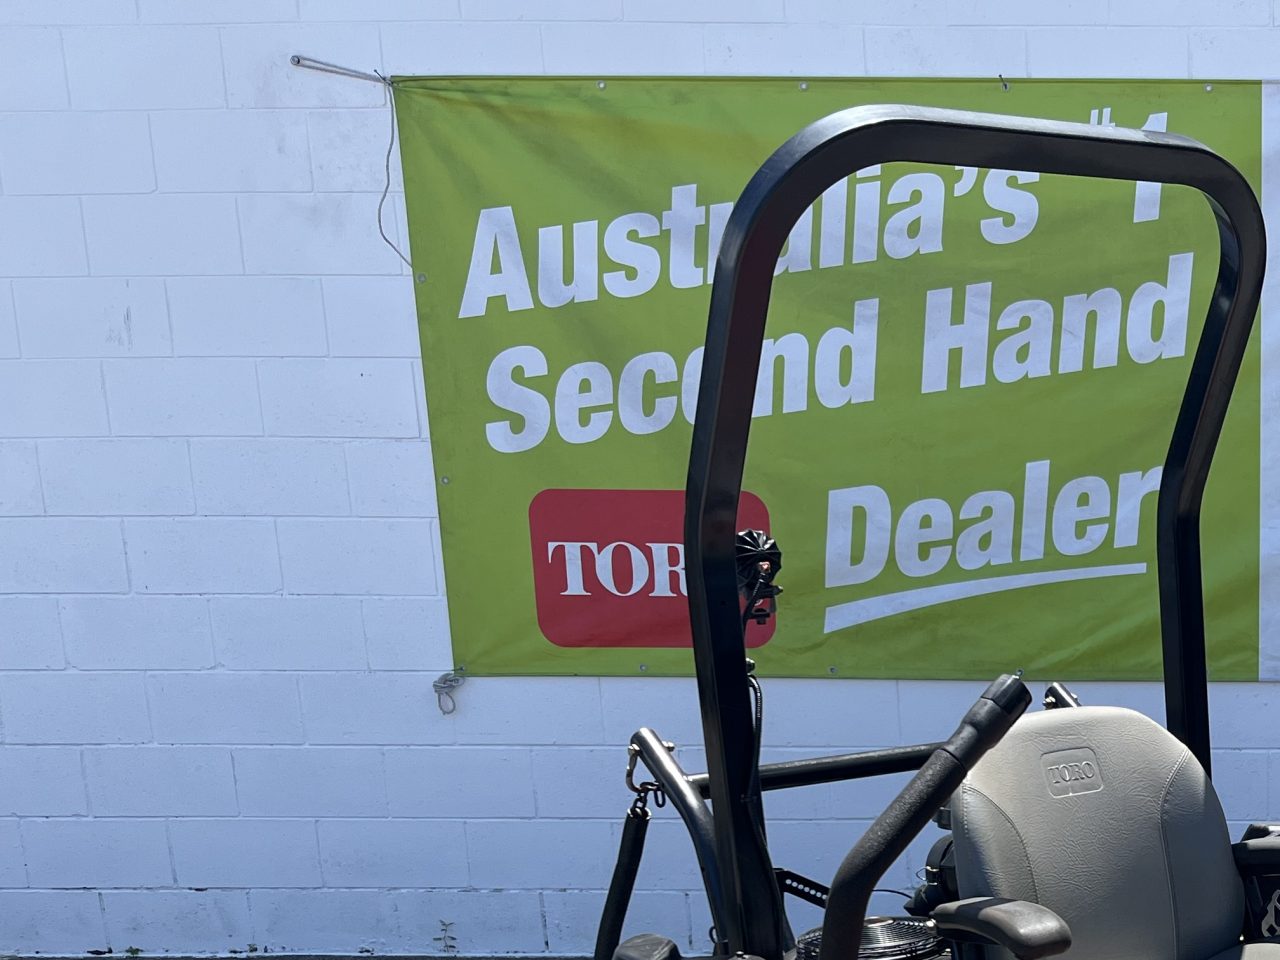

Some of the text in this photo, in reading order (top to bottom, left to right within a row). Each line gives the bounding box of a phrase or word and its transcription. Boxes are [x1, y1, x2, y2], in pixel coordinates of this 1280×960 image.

[486, 252, 1195, 454] Secnd Hand
[547, 540, 690, 598] TOR
[824, 459, 1164, 588] Dealer
[1047, 760, 1096, 785] TORO
